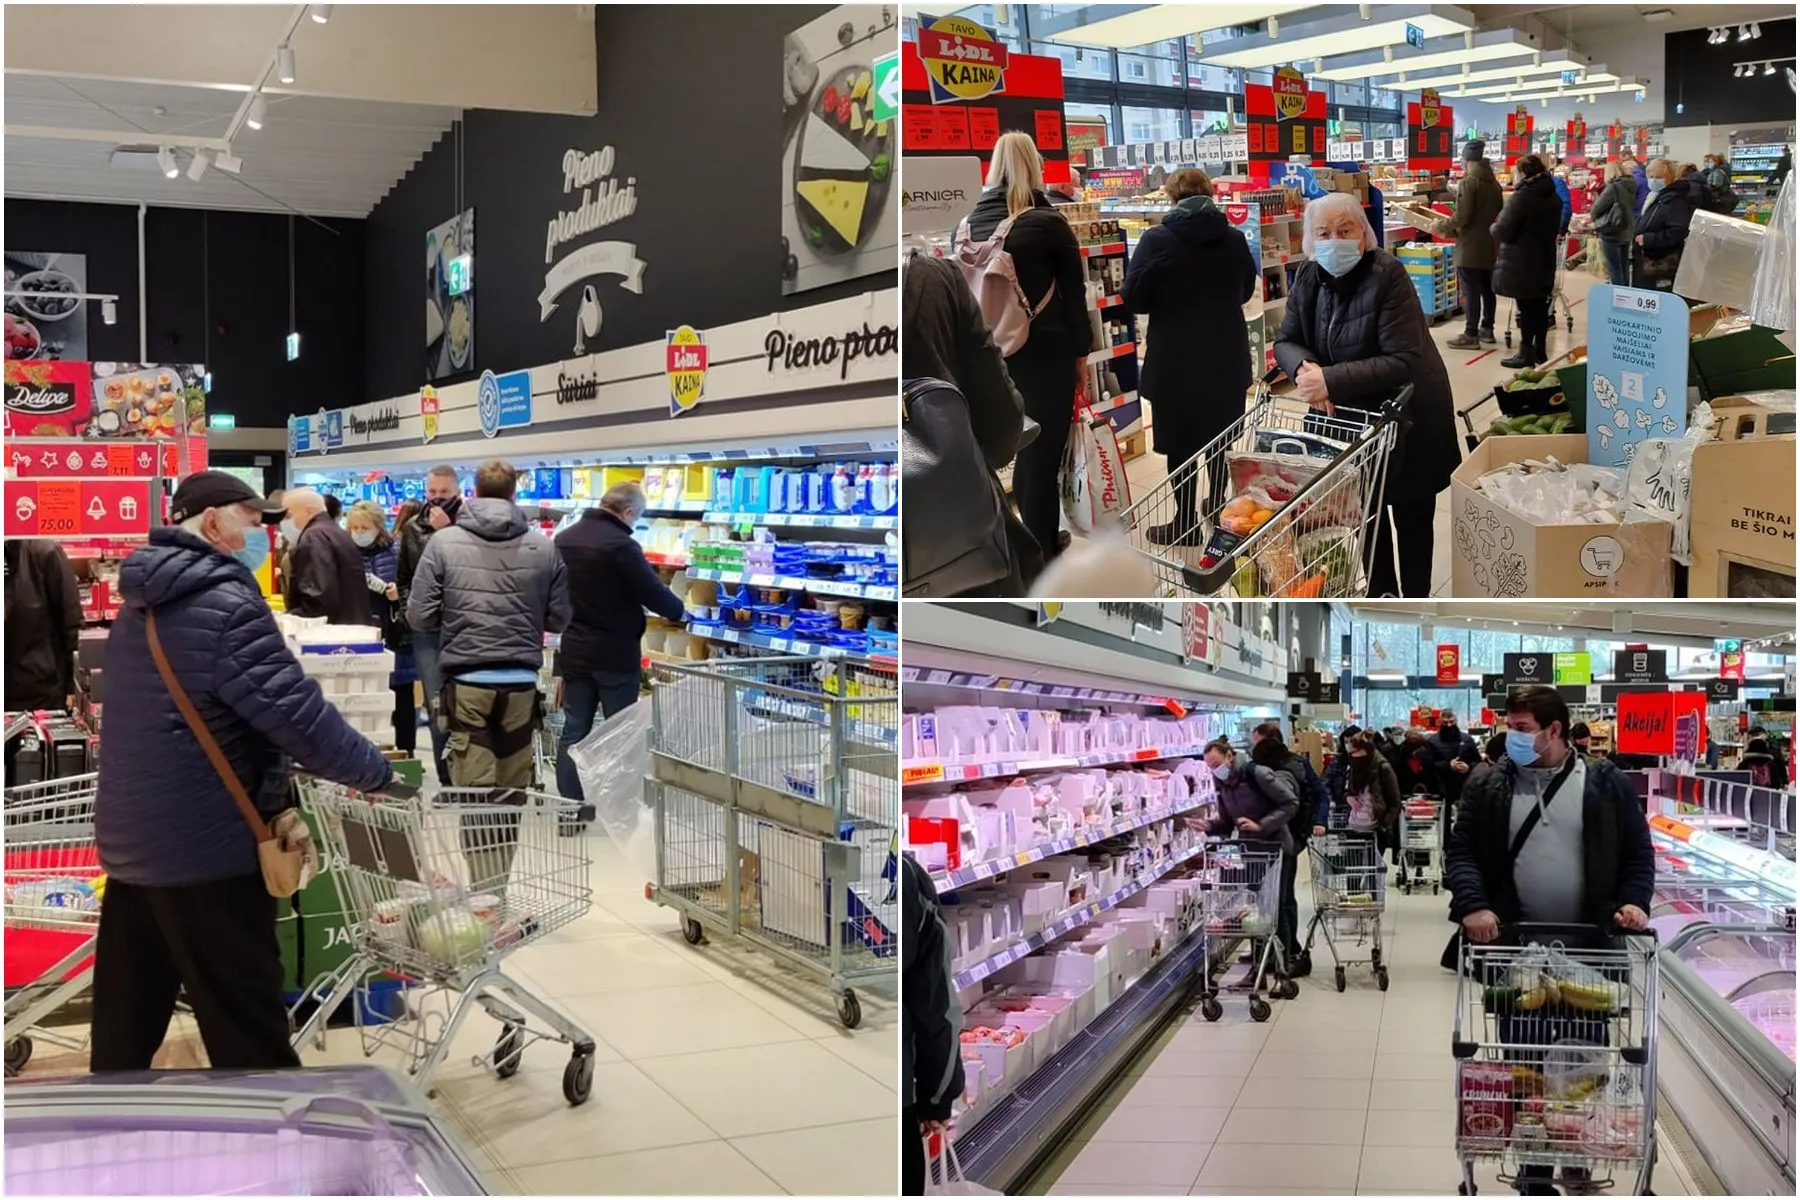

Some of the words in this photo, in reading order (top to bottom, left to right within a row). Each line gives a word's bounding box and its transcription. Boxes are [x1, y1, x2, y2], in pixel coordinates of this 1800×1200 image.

[950, 23, 975, 36] TAVO
[938, 35, 994, 62] LIDL
[942, 63, 995, 85] KAINA
[1280, 78, 1303, 94] LIDL
[1281, 95, 1303, 110] KAINA
[562, 144, 616, 194] Pieno
[544, 176, 638, 264] produktai
[1637, 297, 1656, 310] 0,99
[1607, 317, 1662, 334] DAUGKARTINIO
[1612, 327, 1657, 343] NAUDOJIMO
[763, 329, 841, 373] Pieno
[1616, 335, 1652, 350] MAIŠELIAI
[673, 346, 700, 370] LIDL
[1612, 344, 1646, 359] VAISIAMS
[1647, 352, 1656, 361] IR
[556, 371, 597, 405] Sūriai
[675, 374, 700, 397] KAINA
[1627, 379, 1636, 392] 2
[7, 385, 69, 409] Deluxe
[40, 518, 74, 531] 75,00
[1742, 506, 1791, 526] TIKRAI
[1731, 518, 1748, 531] BE
[1753, 520, 1778, 536] ŠIO
[1623, 709, 1669, 739] Akcija!
